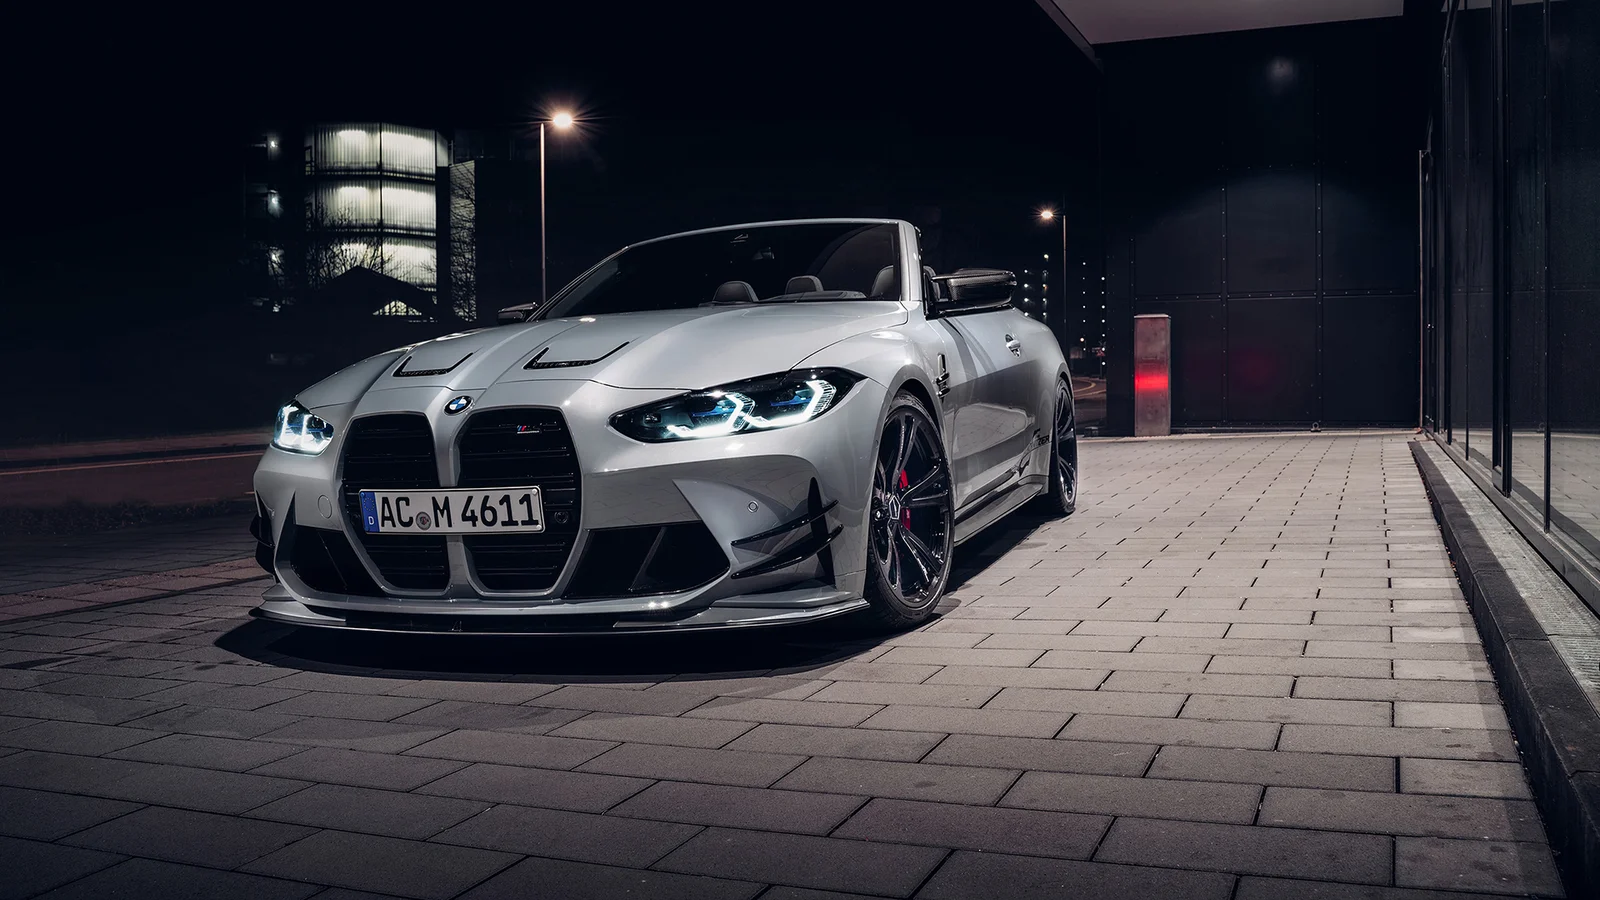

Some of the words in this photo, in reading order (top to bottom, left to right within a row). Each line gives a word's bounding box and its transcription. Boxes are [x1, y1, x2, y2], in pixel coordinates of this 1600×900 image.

[368, 515, 375, 526] D
[380, 496, 414, 528] AC
[431, 496, 453, 528] M
[460, 493, 539, 528] 4611
